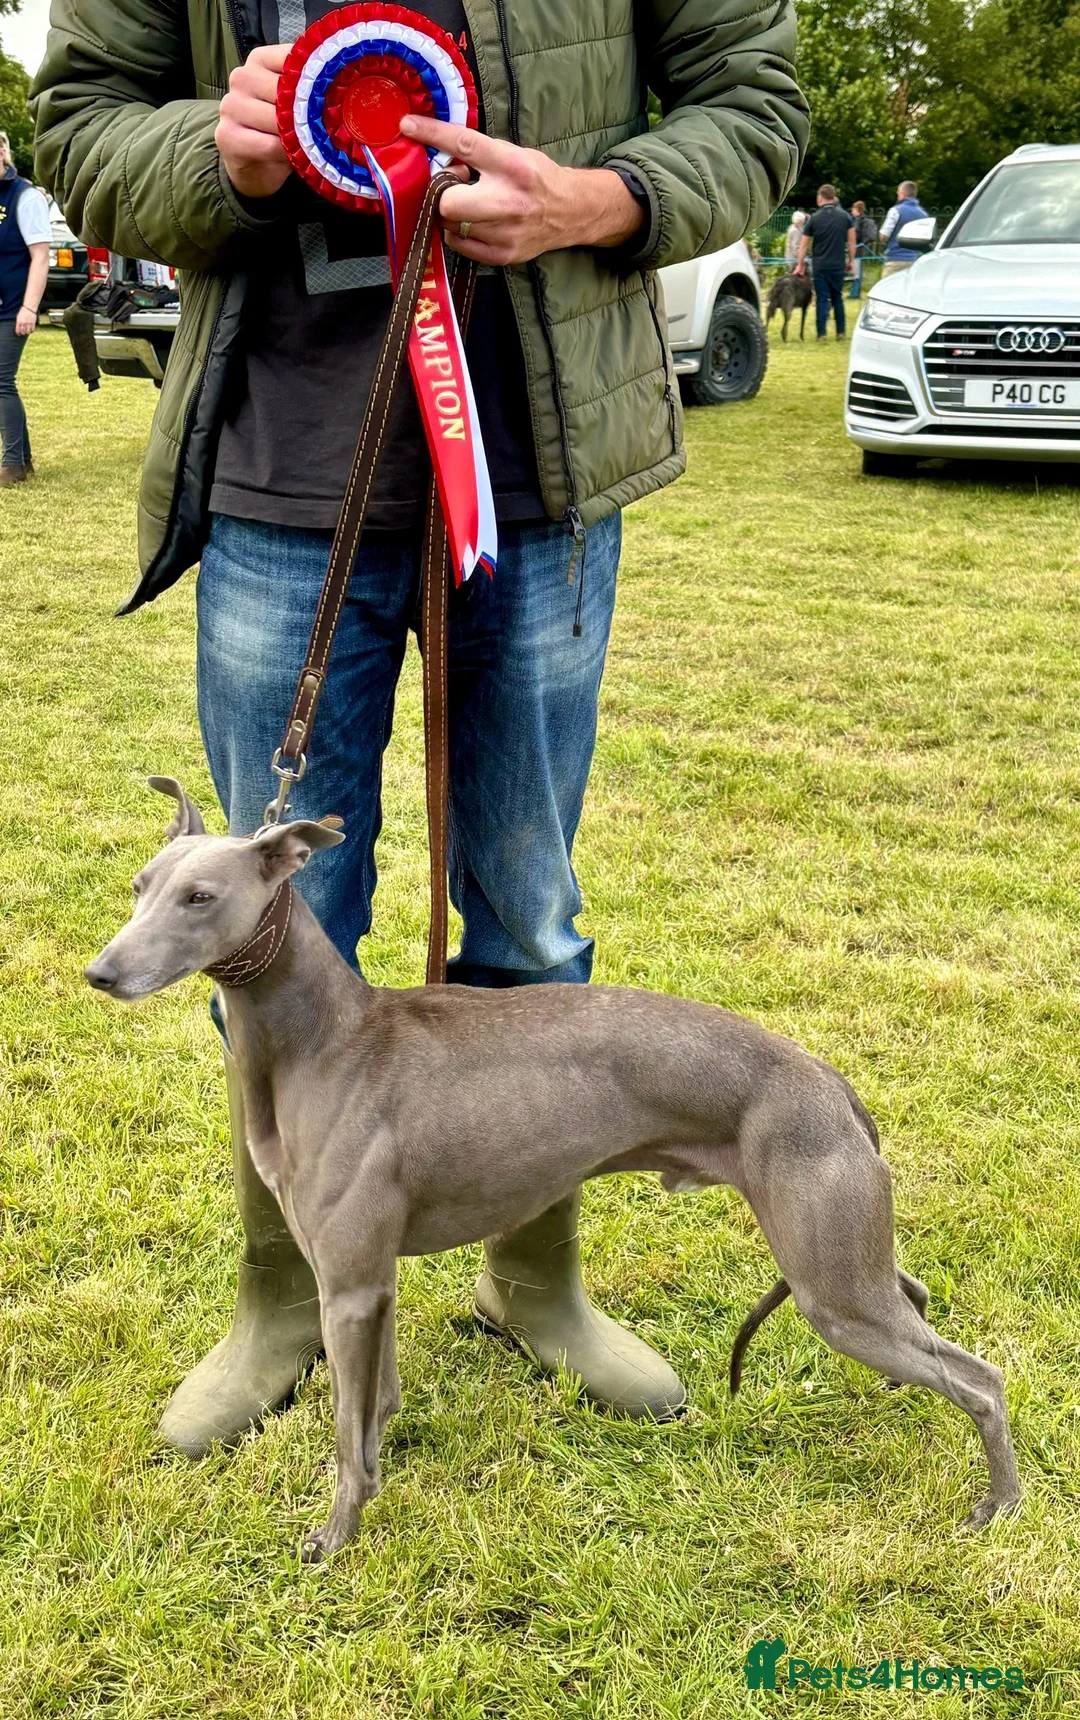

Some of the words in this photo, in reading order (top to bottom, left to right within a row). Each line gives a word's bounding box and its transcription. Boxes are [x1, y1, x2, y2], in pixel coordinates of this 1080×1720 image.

[414, 247, 466, 441] AMPION
[992, 383, 1032, 403] P40
[1038, 384, 1066, 404] CG
